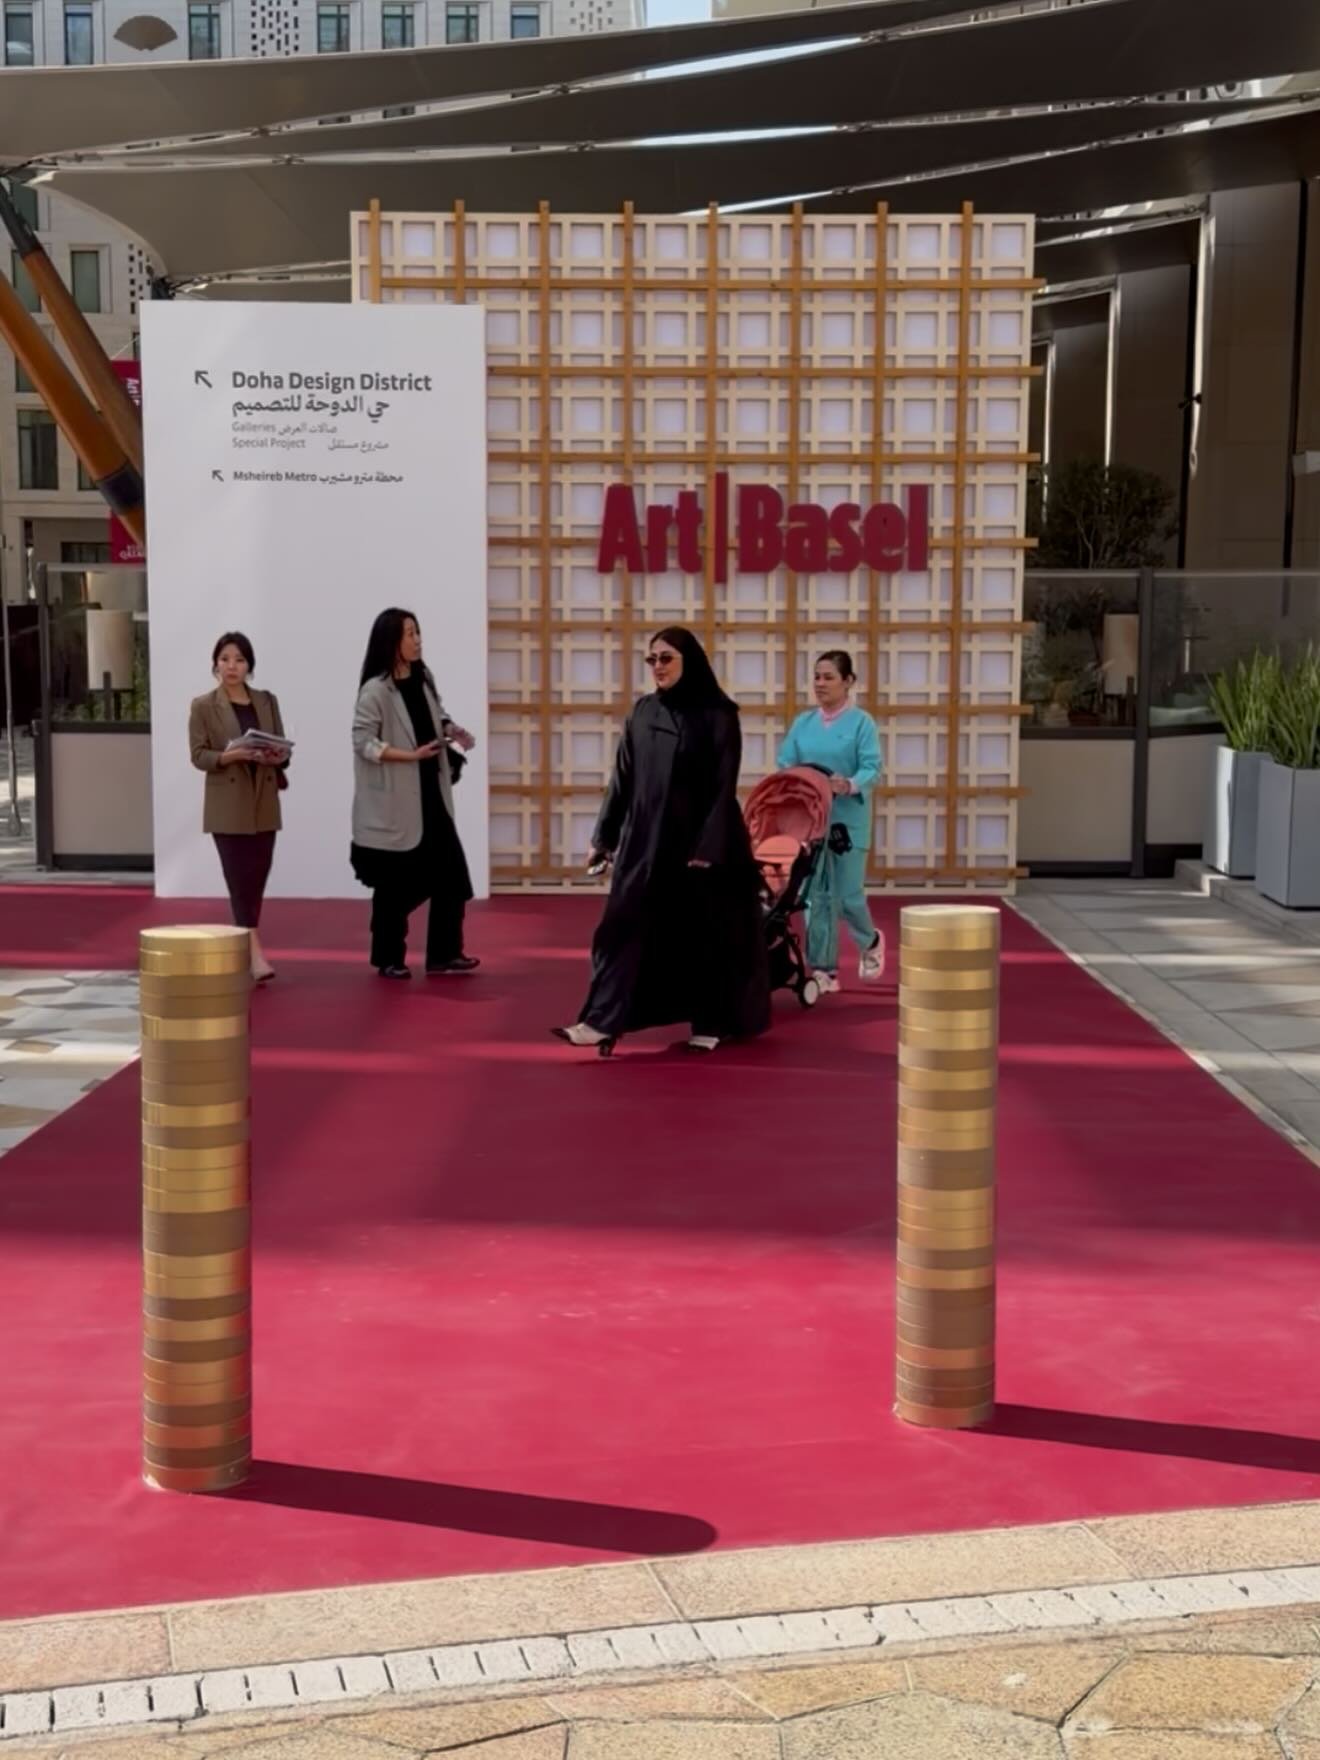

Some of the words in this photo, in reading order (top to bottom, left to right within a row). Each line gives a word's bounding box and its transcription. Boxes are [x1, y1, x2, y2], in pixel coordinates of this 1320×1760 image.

[231, 370, 284, 390] Doha
[288, 371, 356, 395] Design
[359, 373, 432, 392] District
[231, 394, 302, 418] للتصميم
[304, 394, 364, 417] الدوحة
[367, 401, 390, 424] حي
[231, 421, 277, 433] Galleries
[231, 437, 268, 450] Special
[270, 438, 306, 451] Project
[233, 471, 284, 483] Msheireb
[285, 472, 317, 483] Metro
[353, 472, 374, 485] مترو
[374, 471, 404, 484] محطة
